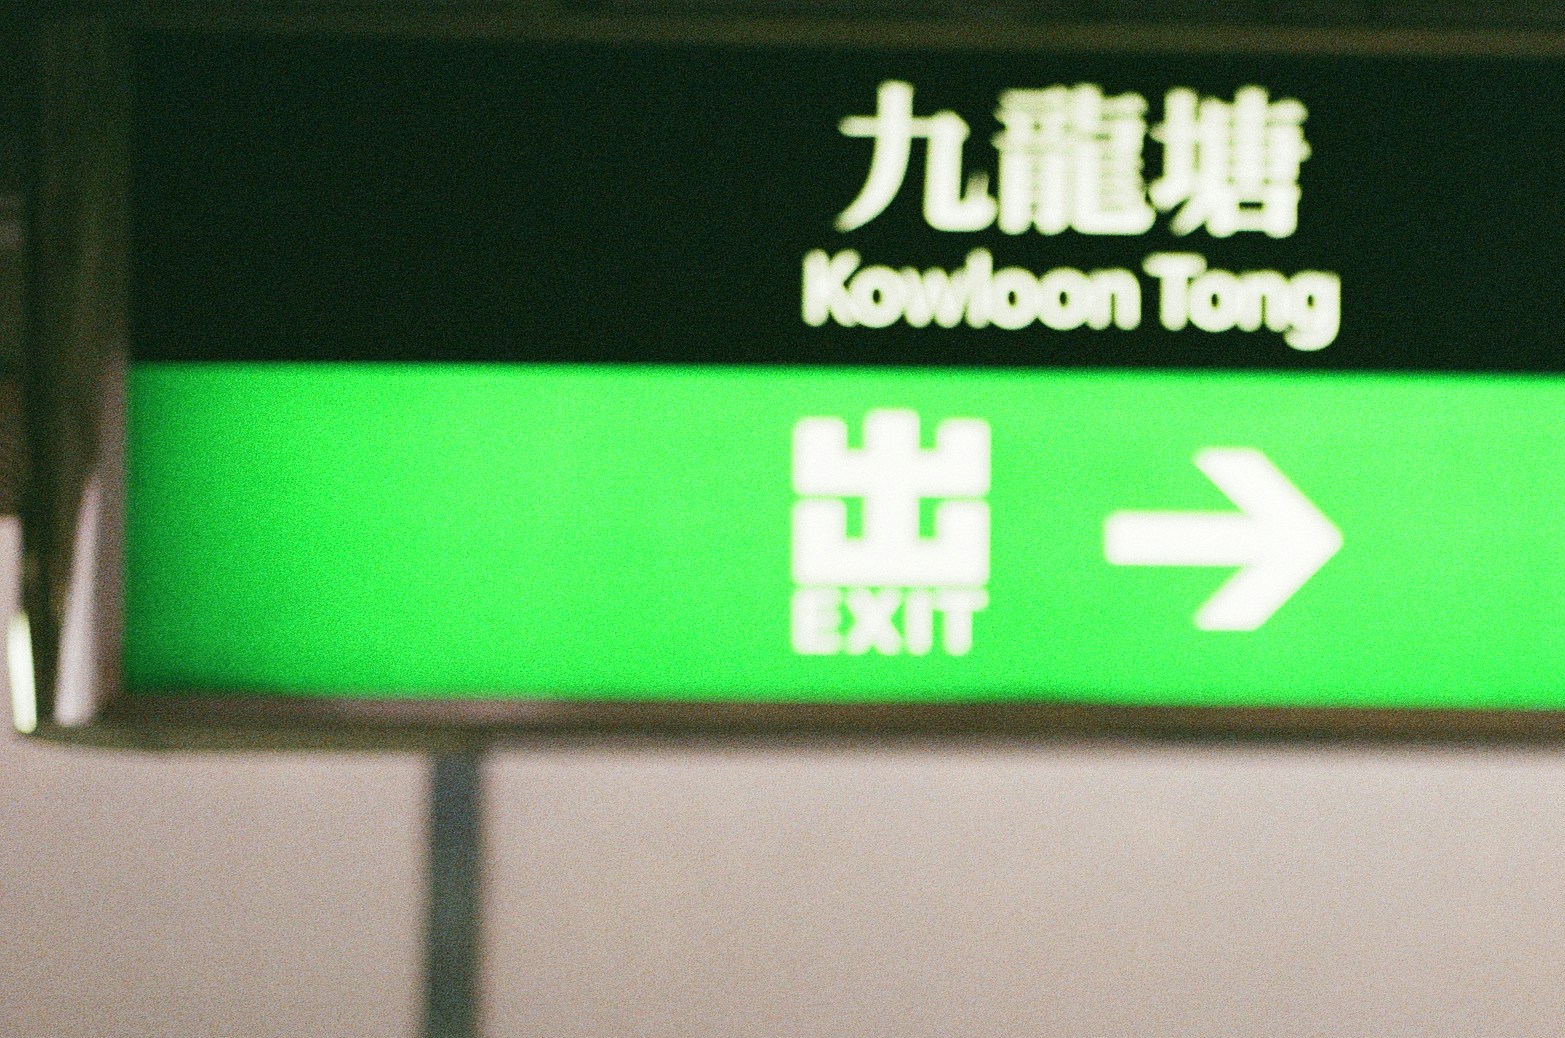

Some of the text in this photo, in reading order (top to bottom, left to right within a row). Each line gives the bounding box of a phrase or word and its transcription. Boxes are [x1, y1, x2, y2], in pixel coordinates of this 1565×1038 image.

[835, 80, 1310, 237] 九龍塘
[802, 248, 1341, 351] Kowloon Tong
[791, 588, 990, 655] EXIT
